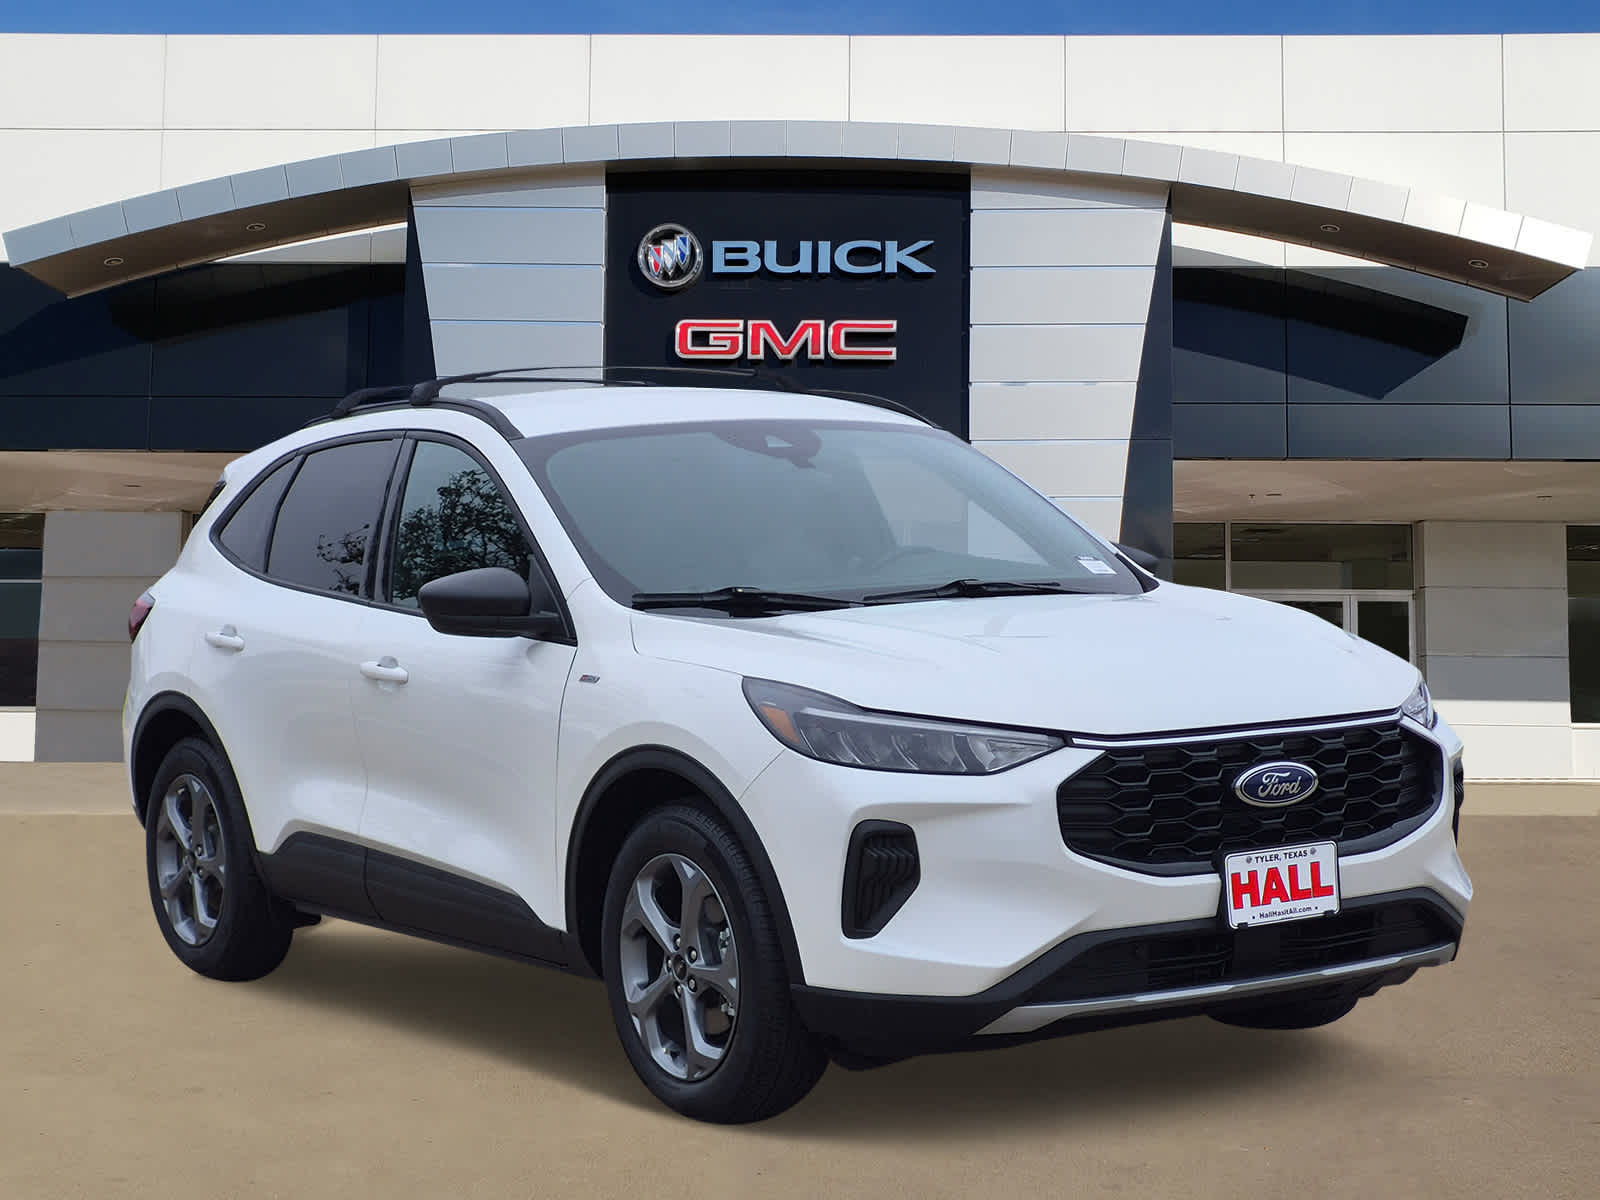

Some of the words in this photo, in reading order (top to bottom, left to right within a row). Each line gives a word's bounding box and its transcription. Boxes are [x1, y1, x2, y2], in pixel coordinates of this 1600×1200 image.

[712, 240, 936, 273] BUICK
[675, 319, 897, 360] GMC
[1258, 772, 1302, 797] Ford
[1255, 853, 1282, 864] TYLER,
[1284, 849, 1308, 859] TEXAS
[1231, 861, 1334, 909] HALL
